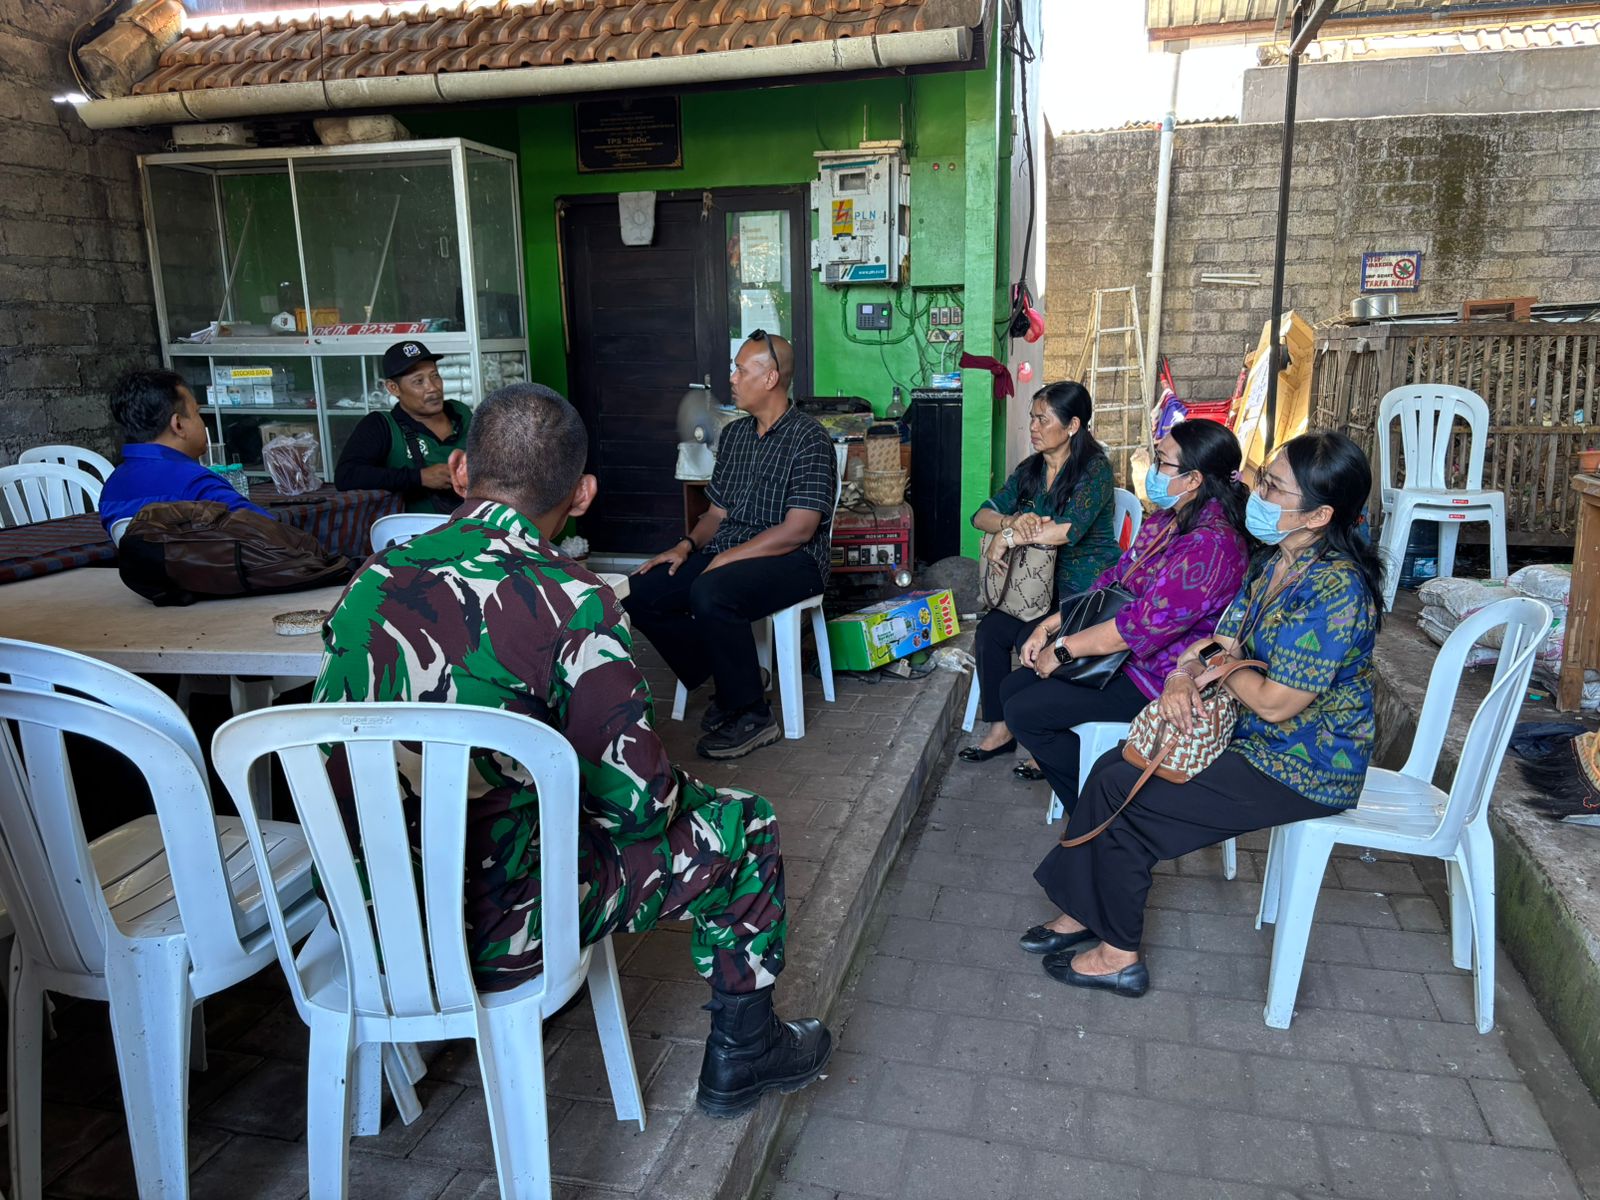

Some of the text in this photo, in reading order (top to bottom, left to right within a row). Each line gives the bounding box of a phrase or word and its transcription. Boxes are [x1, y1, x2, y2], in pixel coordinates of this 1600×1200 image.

[855, 210, 877, 220] PLN
[333, 324, 353, 335] DK
[357, 323, 397, 335] 8235
[938, 592, 954, 636] Yoto
